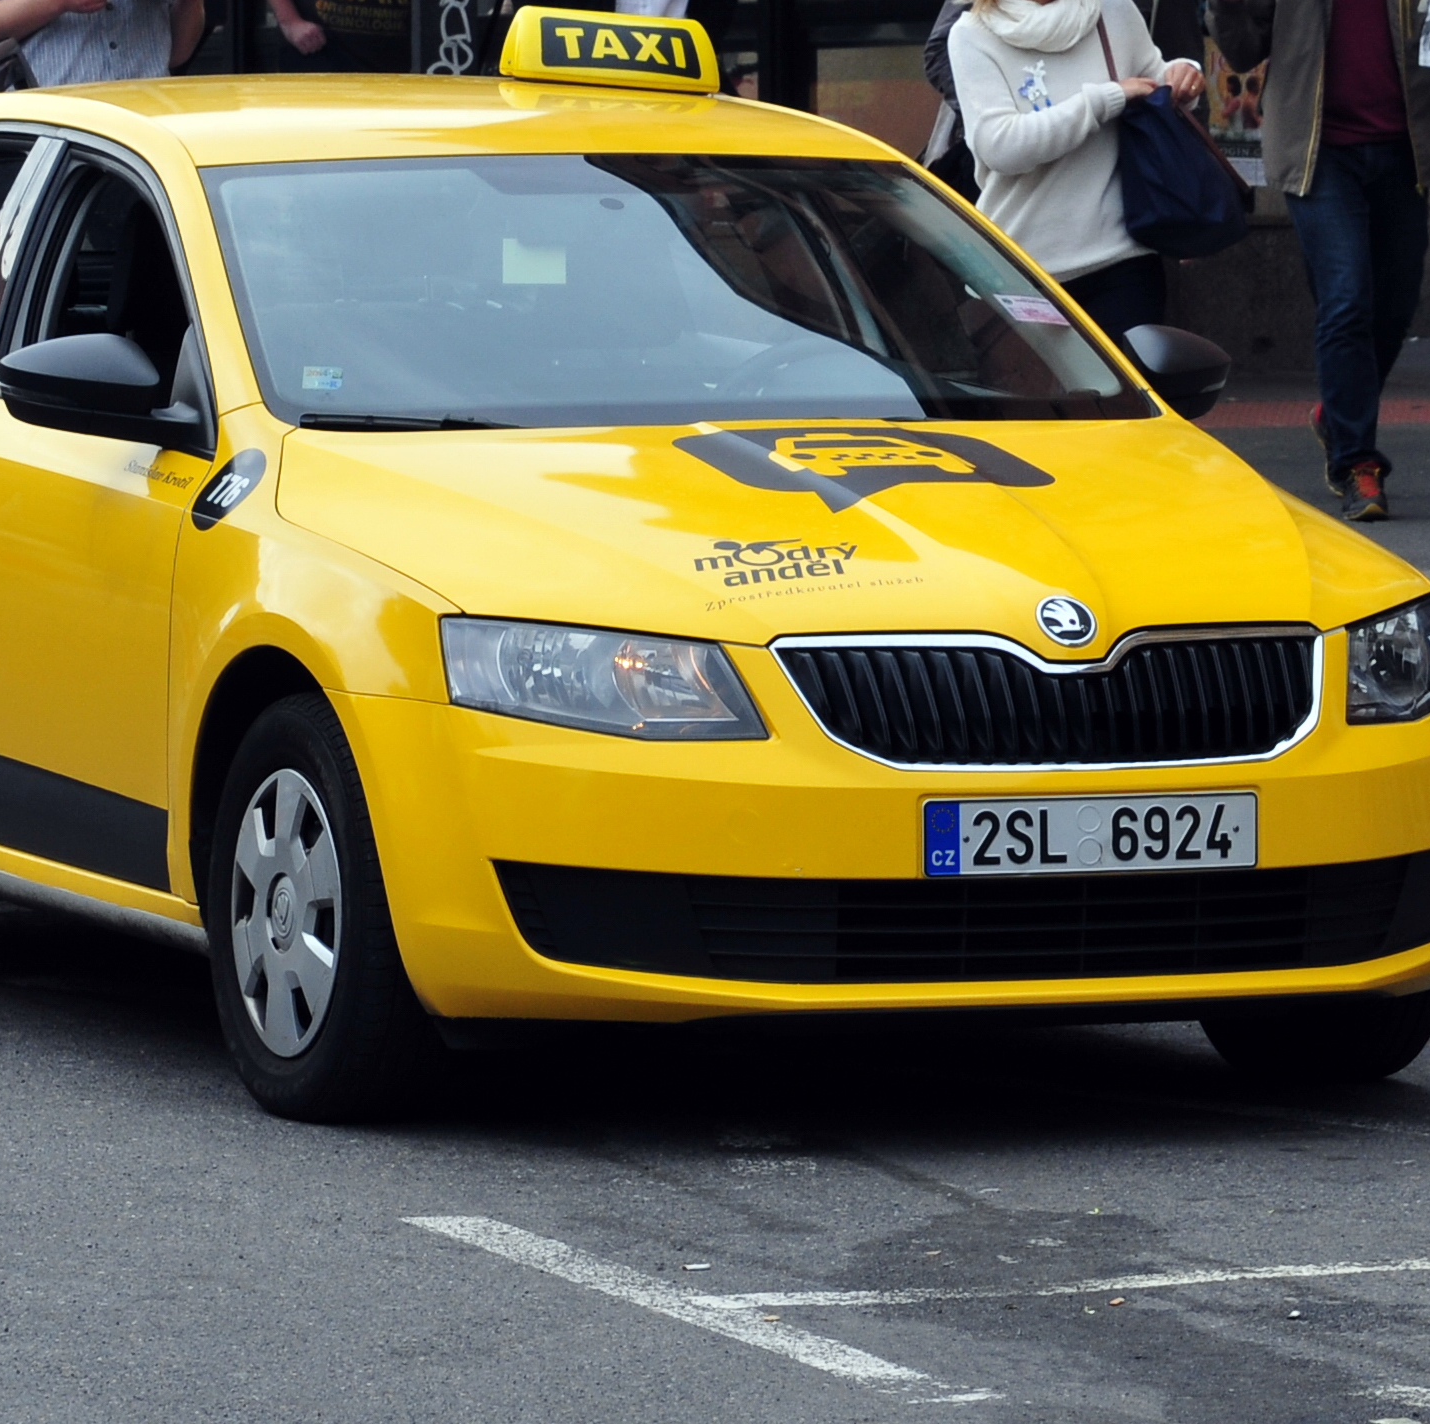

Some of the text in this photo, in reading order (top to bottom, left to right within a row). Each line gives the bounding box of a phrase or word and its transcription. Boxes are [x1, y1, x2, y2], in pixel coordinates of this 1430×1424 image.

[555, 27, 687, 69] TAXI
[206, 472, 251, 508] 176
[693, 542, 859, 572] modrý
[723, 559, 845, 588] anděl
[705, 577, 924, 612] Zprostředkovatel služeb
[971, 802, 1233, 867] 2SL 6924
[931, 849, 957, 867] CZ
